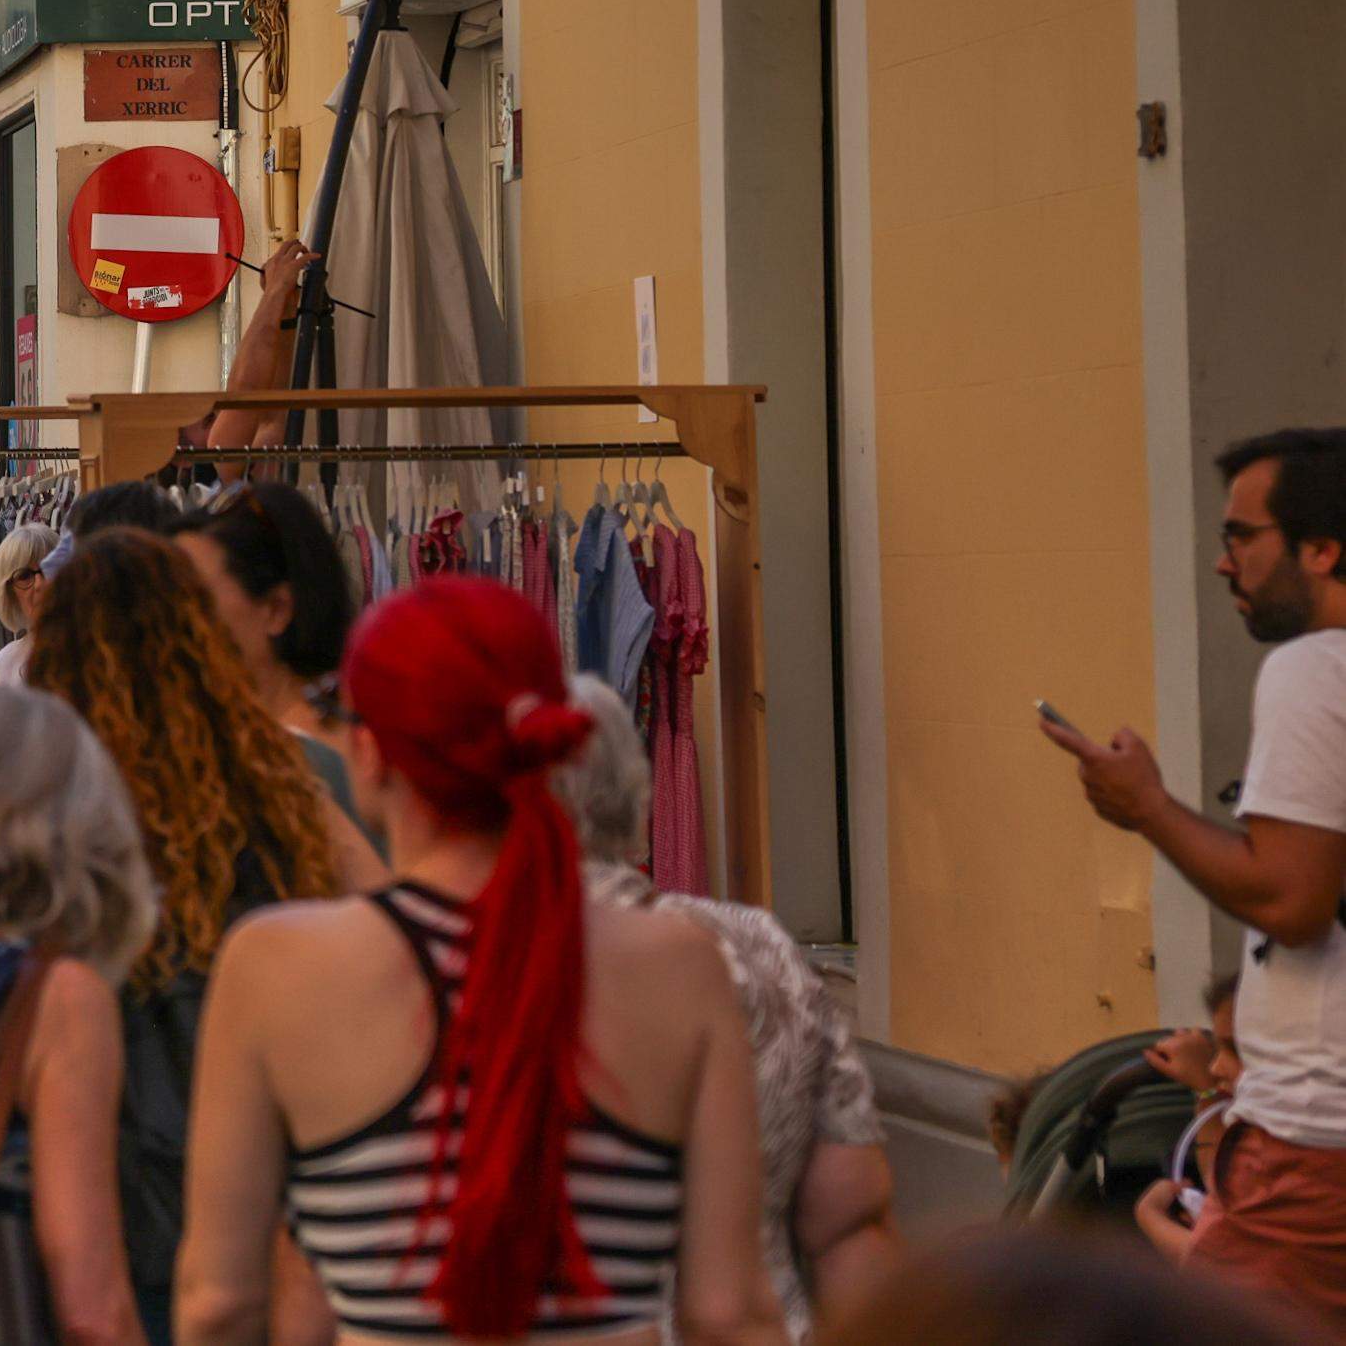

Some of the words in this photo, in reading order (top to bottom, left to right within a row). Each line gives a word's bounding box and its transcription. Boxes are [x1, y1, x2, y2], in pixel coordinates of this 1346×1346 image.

[116, 54, 192, 69] CARRER
[136, 77, 171, 92] DEL
[122, 101, 188, 117] XERRIC
